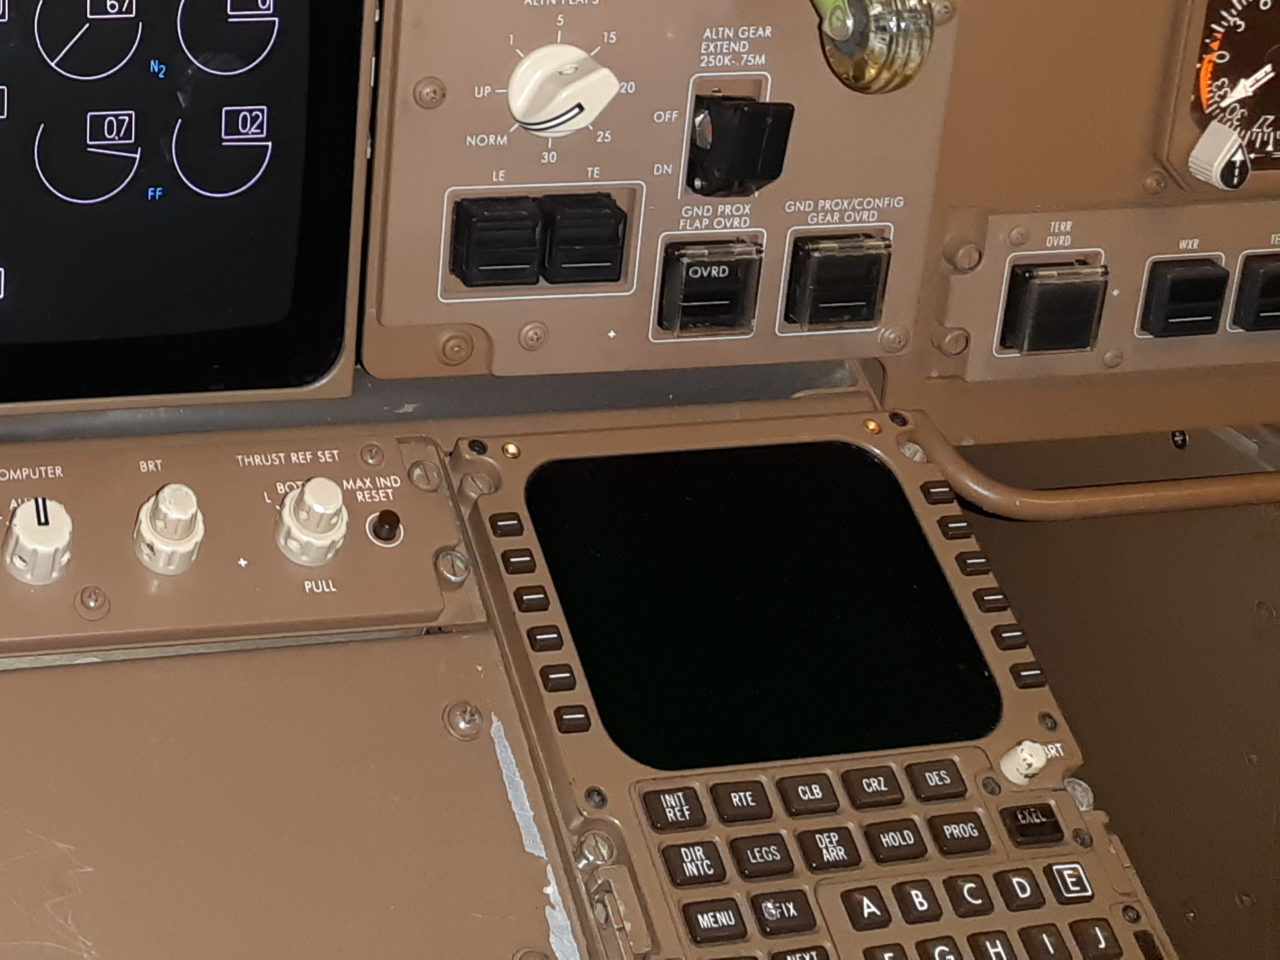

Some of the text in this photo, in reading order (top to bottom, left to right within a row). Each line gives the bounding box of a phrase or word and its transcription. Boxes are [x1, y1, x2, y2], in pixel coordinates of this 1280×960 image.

[603, 32, 617, 44] 15
[703, 26, 772, 39] ALTN GEAR
[700, 41, 749, 54] EXTEND
[475, 86, 492, 98] UP
[653, 111, 680, 122] OFF
[466, 135, 508, 147] NORM
[596, 131, 612, 143] 25
[541, 151, 557, 164] 30
[492, 171, 505, 182] LE
[586, 167, 601, 179] TE
[653, 164, 672, 176] DN
[148, 188, 163, 200] FF
[681, 203, 752, 218] GND PROX
[784, 196, 905, 213] GND PROX/CONFIG
[679, 216, 751, 230] FLAP OVRD
[807, 210, 878, 224] GEAR OVRD
[1049, 221, 1073, 233] TERR
[1046, 235, 1072, 247] OVRD
[1178, 238, 1200, 250] WXR
[688, 266, 729, 279] OVRD
[139, 459, 163, 472] BRT
[236, 449, 340, 468] THRUST REF SET
[342, 475, 401, 492] MAX IND
[355, 489, 395, 503] RESET
[304, 580, 337, 593] PULL
[862, 777, 888, 793] CRZ
[925, 770, 951, 787] DES
[730, 792, 757, 807] RTE
[797, 785, 823, 800] CLB
[660, 792, 685, 808] INIT
[665, 807, 692, 822] REF
[943, 823, 979, 840] PROG
[815, 833, 839, 848] DEP
[880, 830, 915, 848] HOLD
[680, 846, 704, 862] DIR
[747, 846, 781, 863] LEGS
[822, 846, 848, 862] ARR
[682, 860, 714, 877] INTC
[697, 910, 736, 929] MENU
